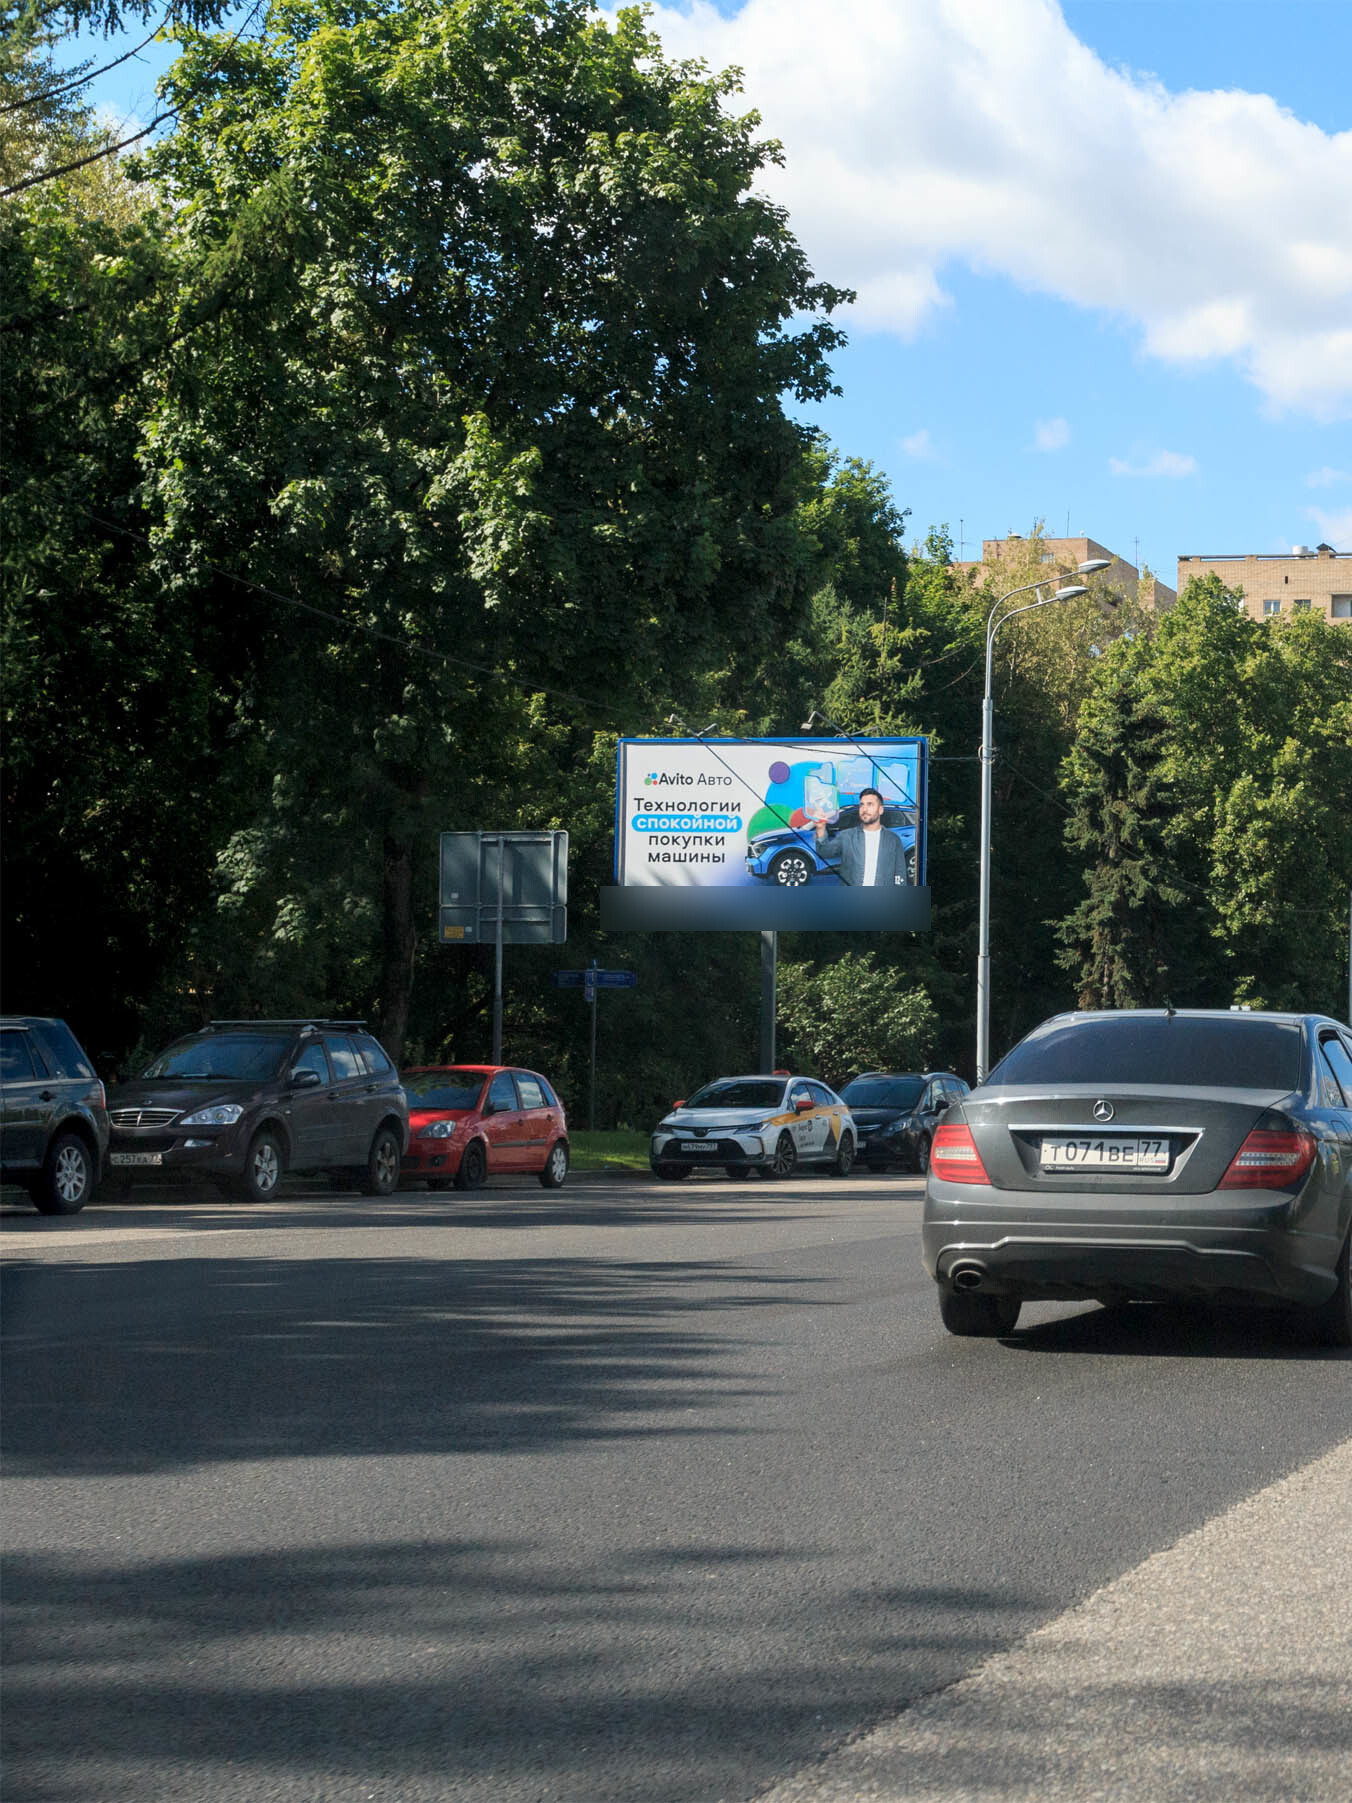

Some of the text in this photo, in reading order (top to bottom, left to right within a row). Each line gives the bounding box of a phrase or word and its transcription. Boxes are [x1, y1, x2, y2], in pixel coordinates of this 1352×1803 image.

[659, 773, 732, 785] Avito Авто
[634, 797, 741, 812] Технологии
[637, 815, 737, 829] спокойной
[649, 835, 724, 849] покупки
[648, 852, 724, 863] машины
